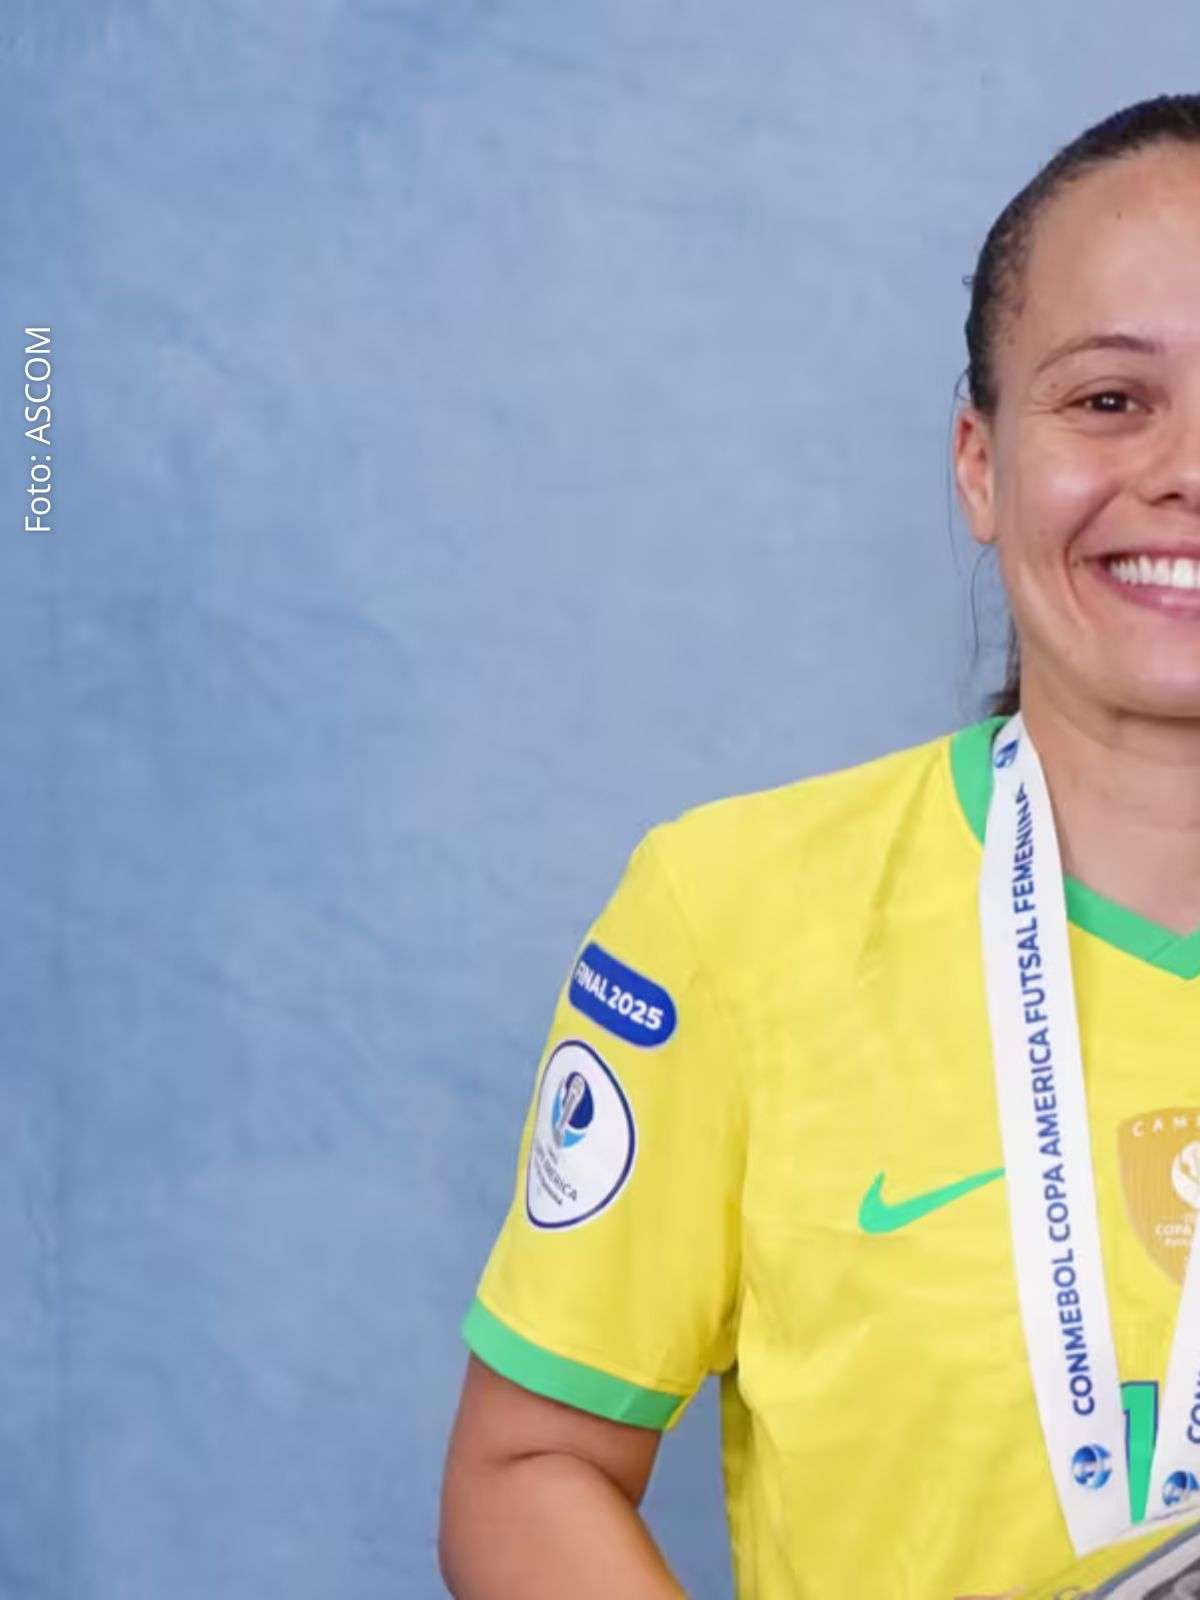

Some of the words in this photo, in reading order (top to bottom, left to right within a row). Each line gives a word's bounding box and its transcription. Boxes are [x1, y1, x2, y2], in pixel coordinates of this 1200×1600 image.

[1012, 782, 1036, 914] FEMENINA
[607, 985, 664, 1030] 2025
[1016, 917, 1048, 1024] FUTSAL
[1028, 1027, 1063, 1157] AMERICA
[1044, 1163, 1072, 1243] COPA
[1050, 1248, 1095, 1417] CONMEBOL
